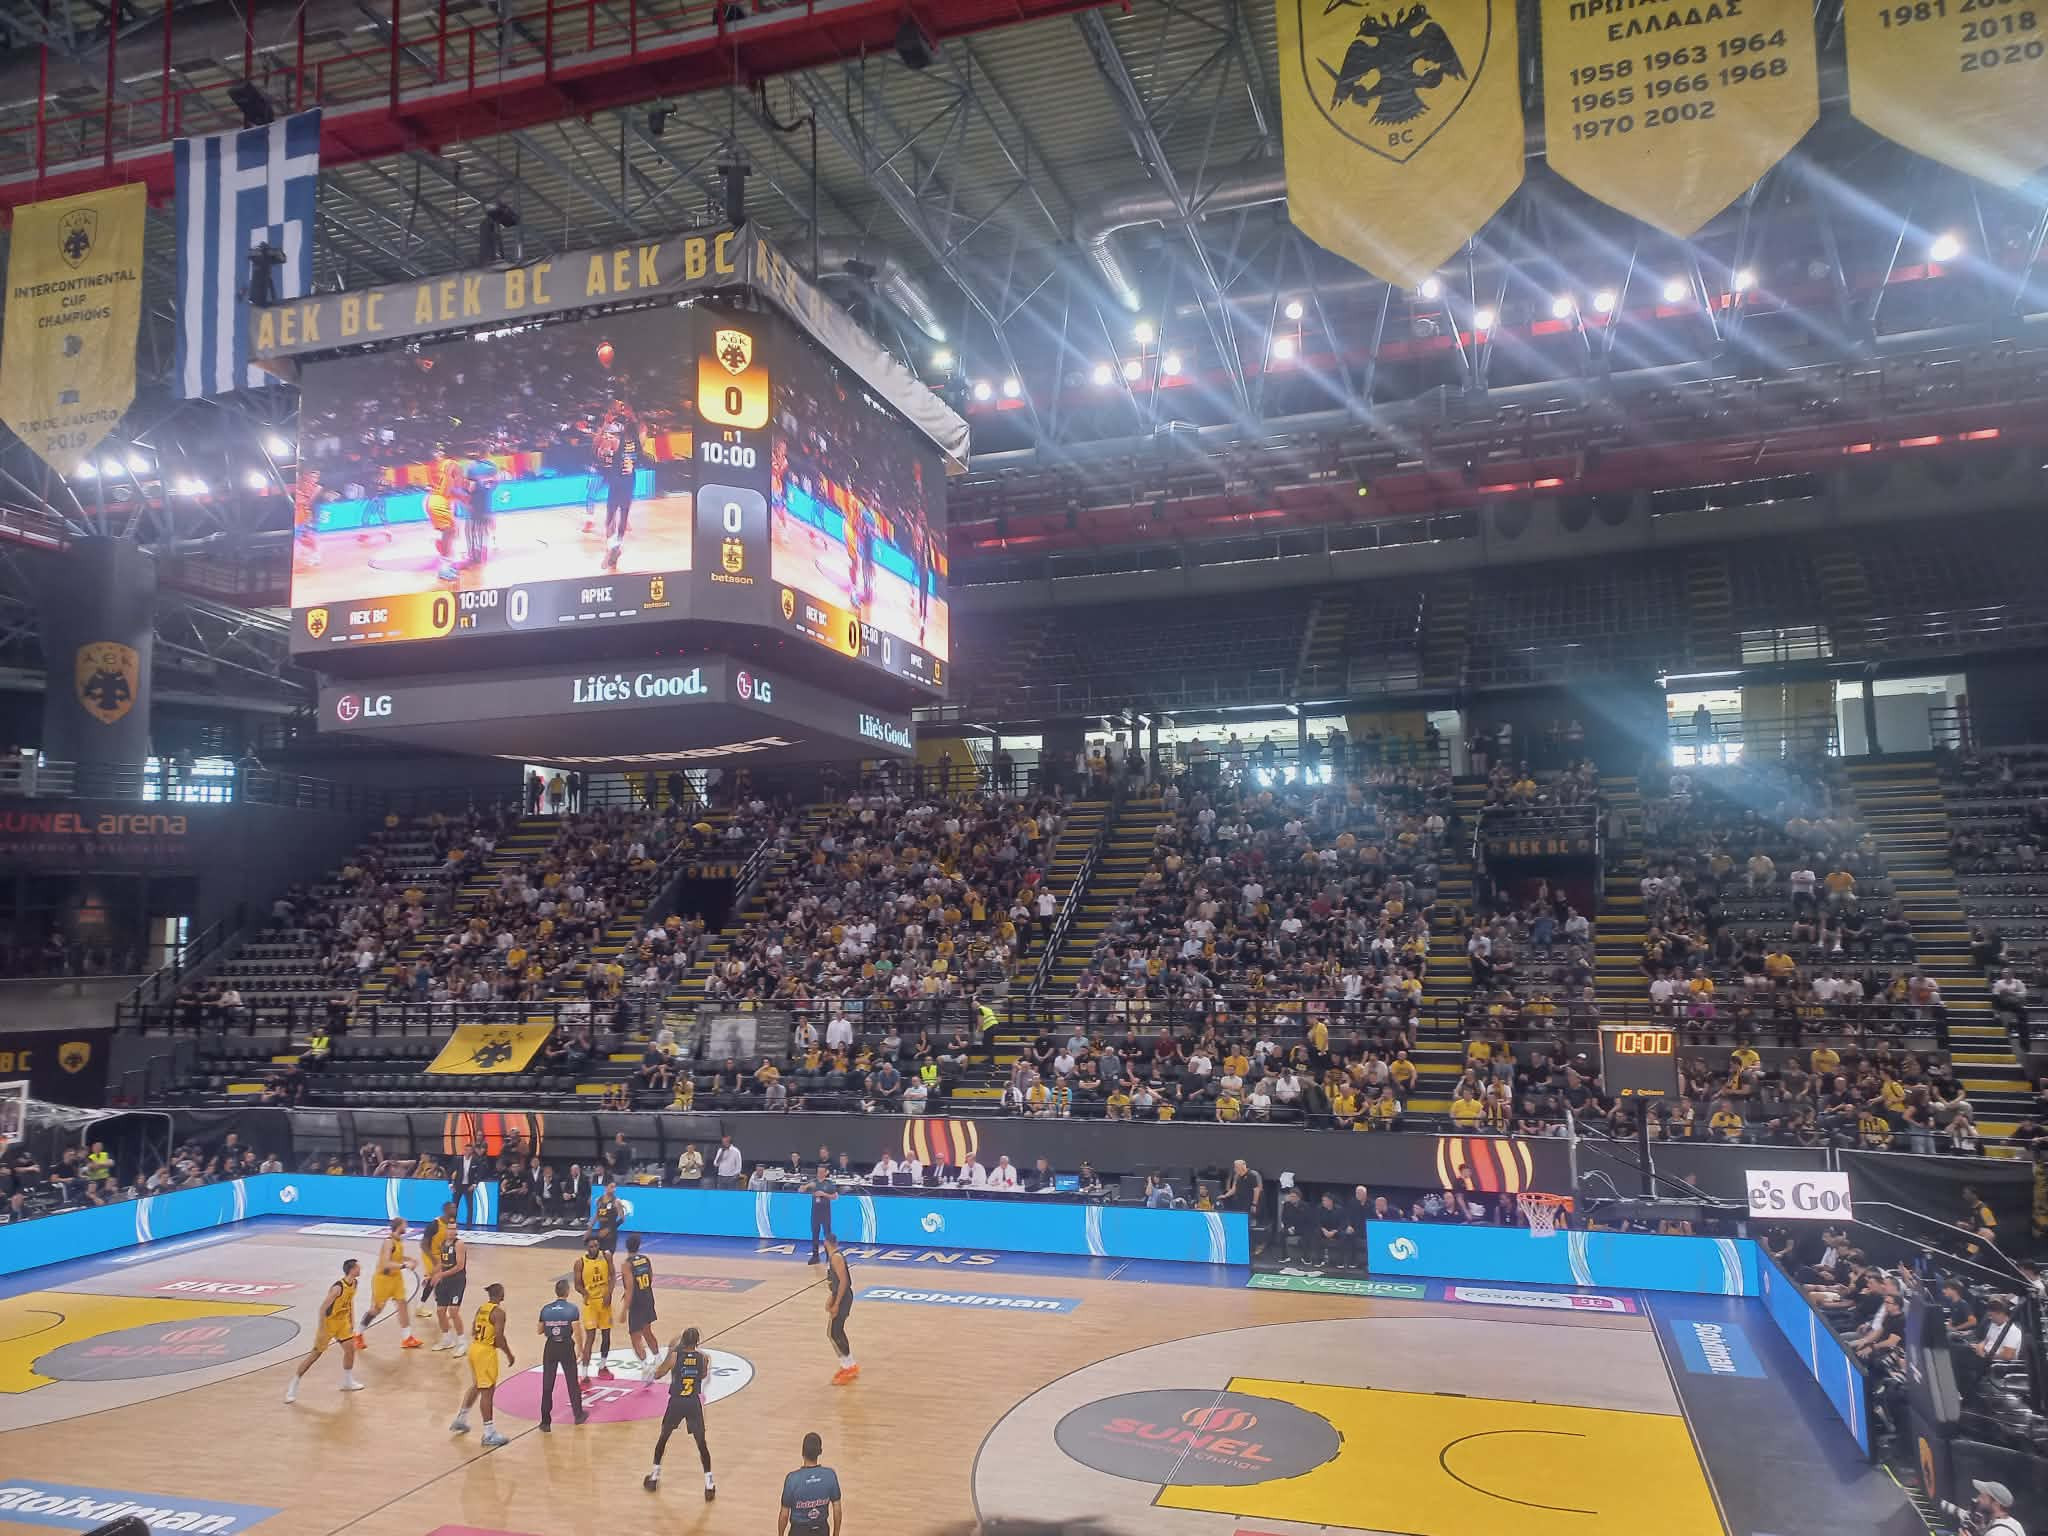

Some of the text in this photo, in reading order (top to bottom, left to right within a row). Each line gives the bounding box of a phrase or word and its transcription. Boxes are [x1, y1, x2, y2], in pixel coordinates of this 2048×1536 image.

[1607, 0, 1743, 42] ΕΛΛΑΔΑΣ
[1879, 0, 1946, 28] 1981
[1961, 11, 2037, 43] 2018
[1569, 29, 1787, 86] 1958 1963 1964
[1960, 41, 2044, 72] 2020
[1571, 58, 1788, 113] 1965 1966 1968
[1572, 101, 1716, 141] 1970 2002
[1387, 128, 1414, 147] BC
[14, 270, 136, 299] INTERCONTINENTAL
[258, 231, 736, 350] AEK BC AEK BC AEK BC
[62, 294, 87, 307] CUP
[38, 307, 111, 329] CHAMPIONS
[725, 387, 742, 415] 0
[701, 441, 756, 468] 10:00
[723, 503, 742, 533] 0
[432, 597, 449, 629] 0
[459, 590, 498, 609] 10:00
[511, 589, 529, 622] 0
[883, 637, 891, 665] 0
[573, 667, 708, 703] Life's Good.
[754, 681, 771, 703] LG
[364, 696, 392, 718] LG
[860, 714, 912, 749] Life's Good.
[0, 813, 187, 834] UNEL arena
[1616, 1033, 1672, 1054] 10:00
[1750, 1180, 1785, 1209] e's
[753, 1244, 1002, 1265] AHENS
[636, 1273, 650, 1290] 10
[1302, 1279, 1417, 1293] VECHRO
[1465, 1292, 1562, 1303] COSMOTE
[680, 1378, 695, 1396] 3
[1104, 1418, 1272, 1462] SUNEL
